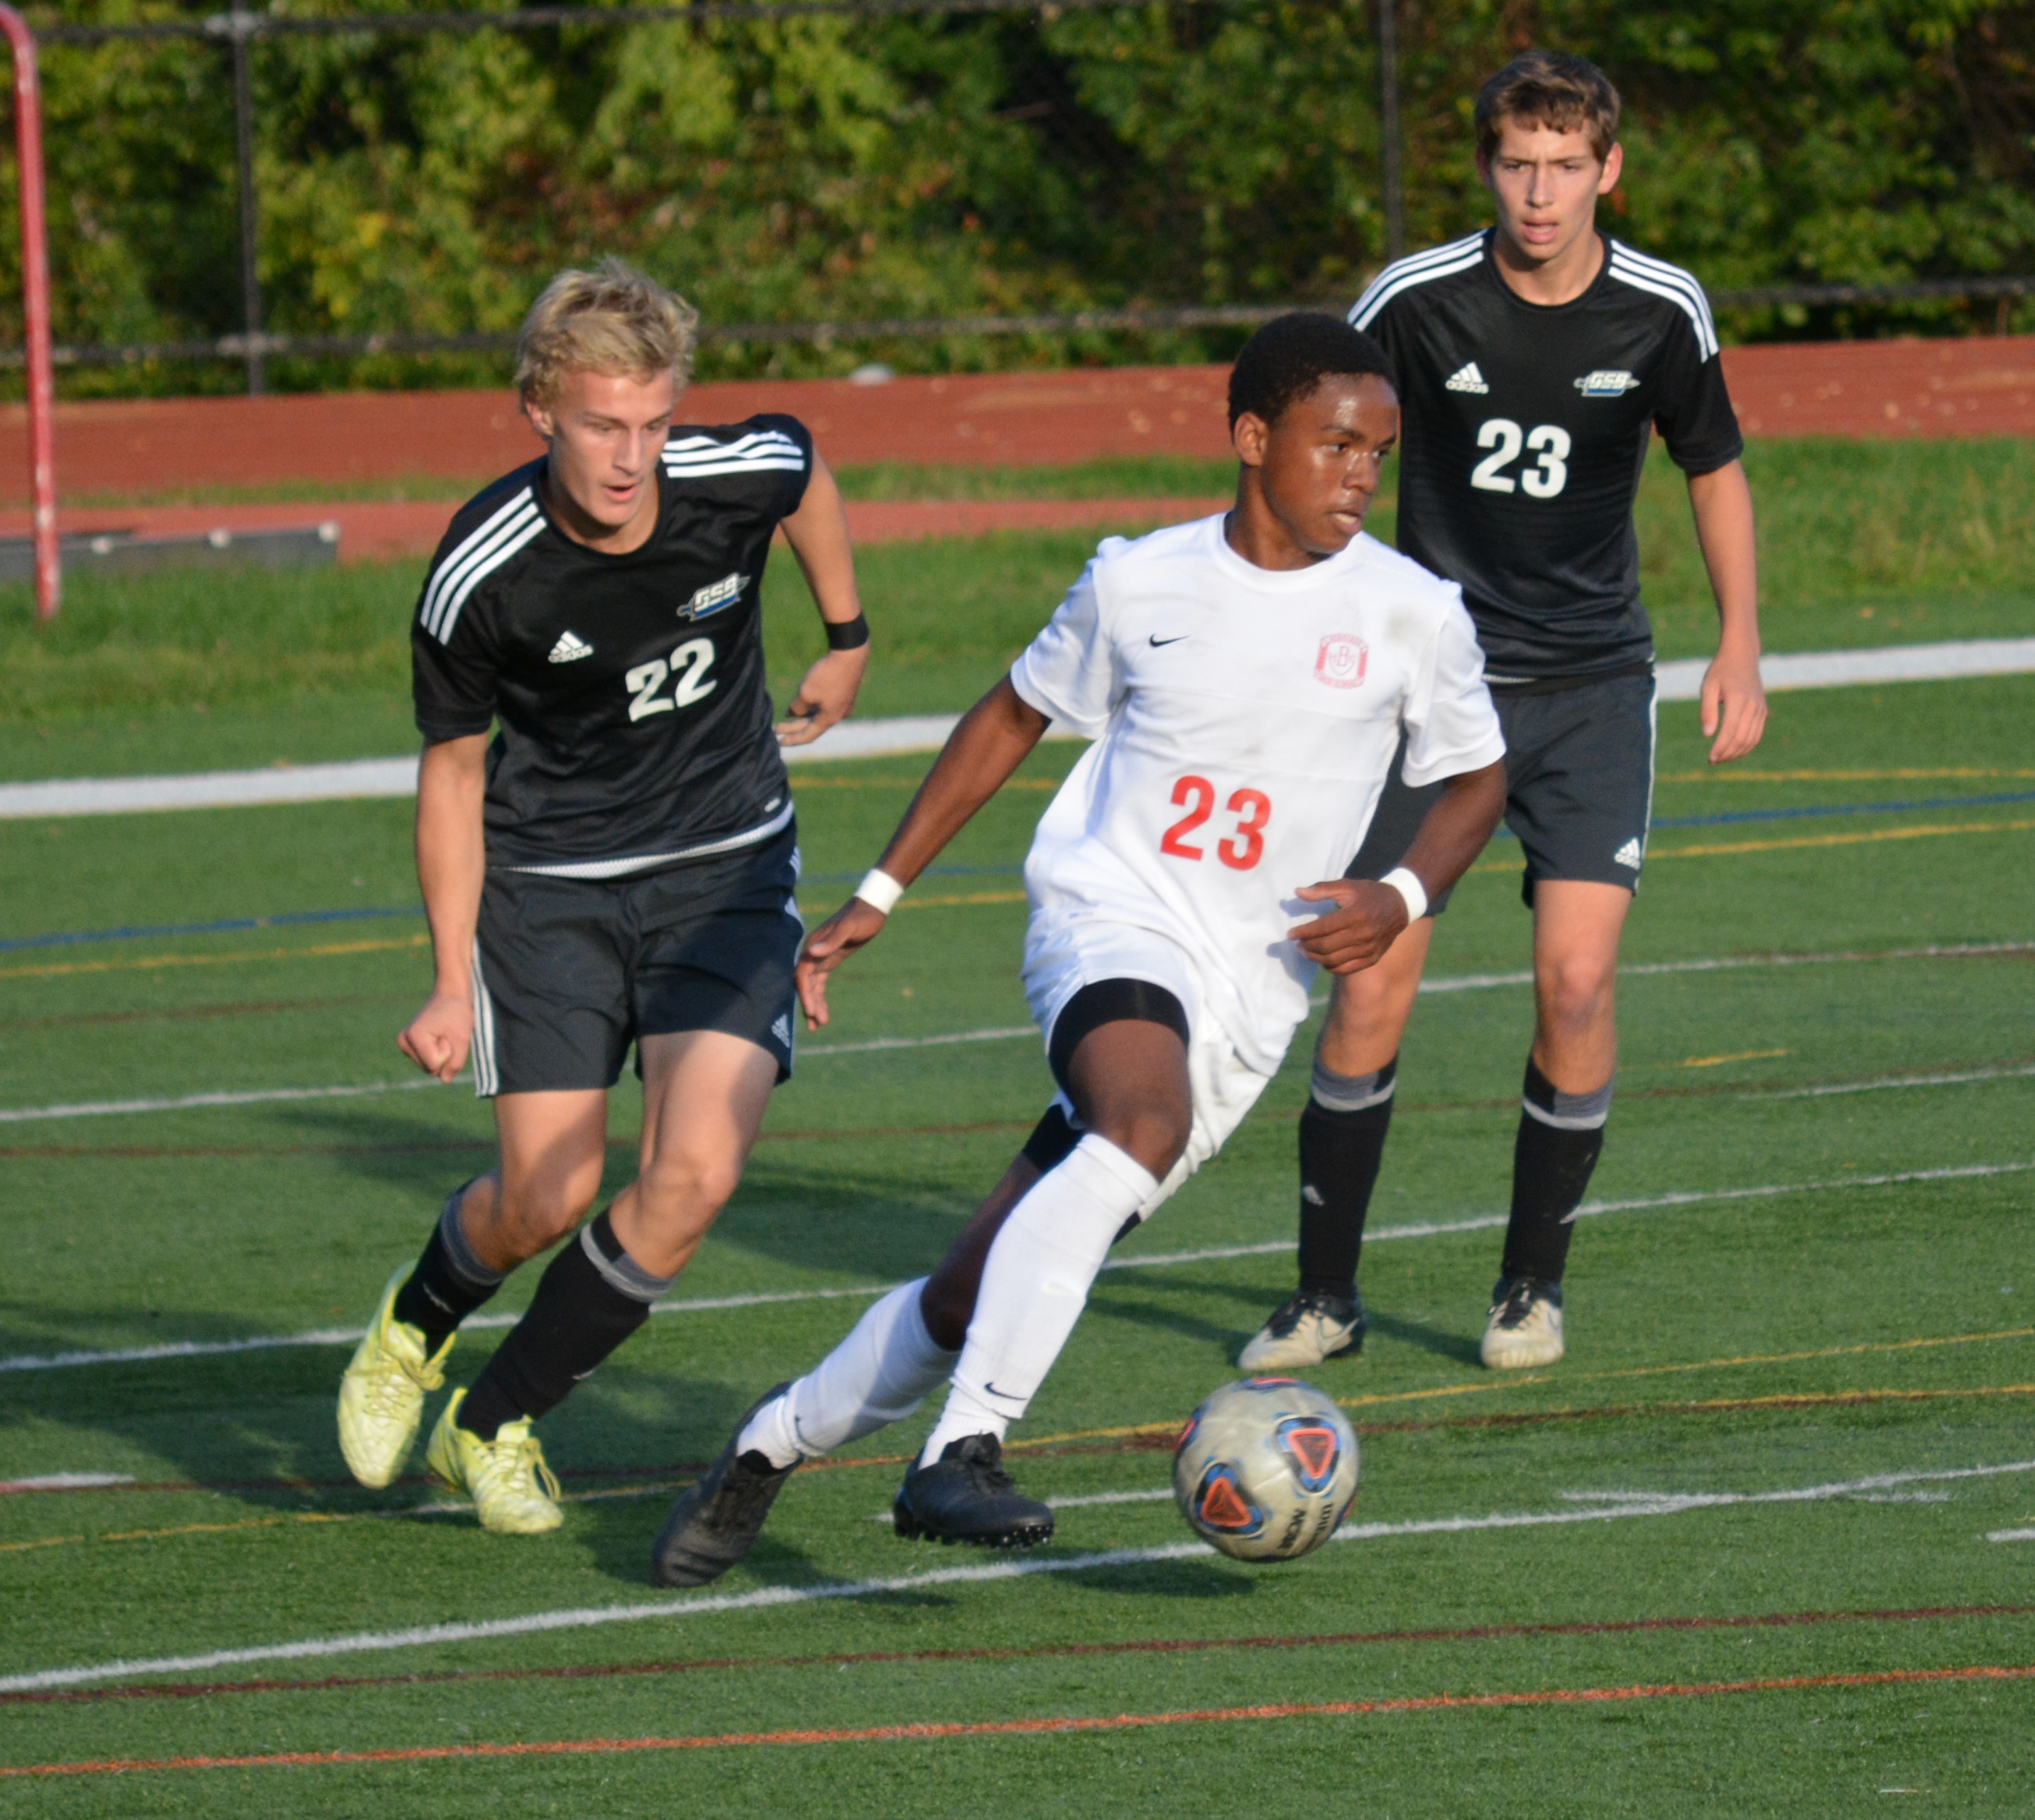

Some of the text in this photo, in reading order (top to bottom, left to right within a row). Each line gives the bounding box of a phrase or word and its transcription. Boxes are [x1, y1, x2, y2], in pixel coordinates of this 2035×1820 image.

[1445, 380, 1489, 394] adidas
[1470, 418, 1572, 499] 23
[548, 644, 594, 664] adidas
[625, 637, 718, 723] 22
[1160, 774, 1272, 871] 23
